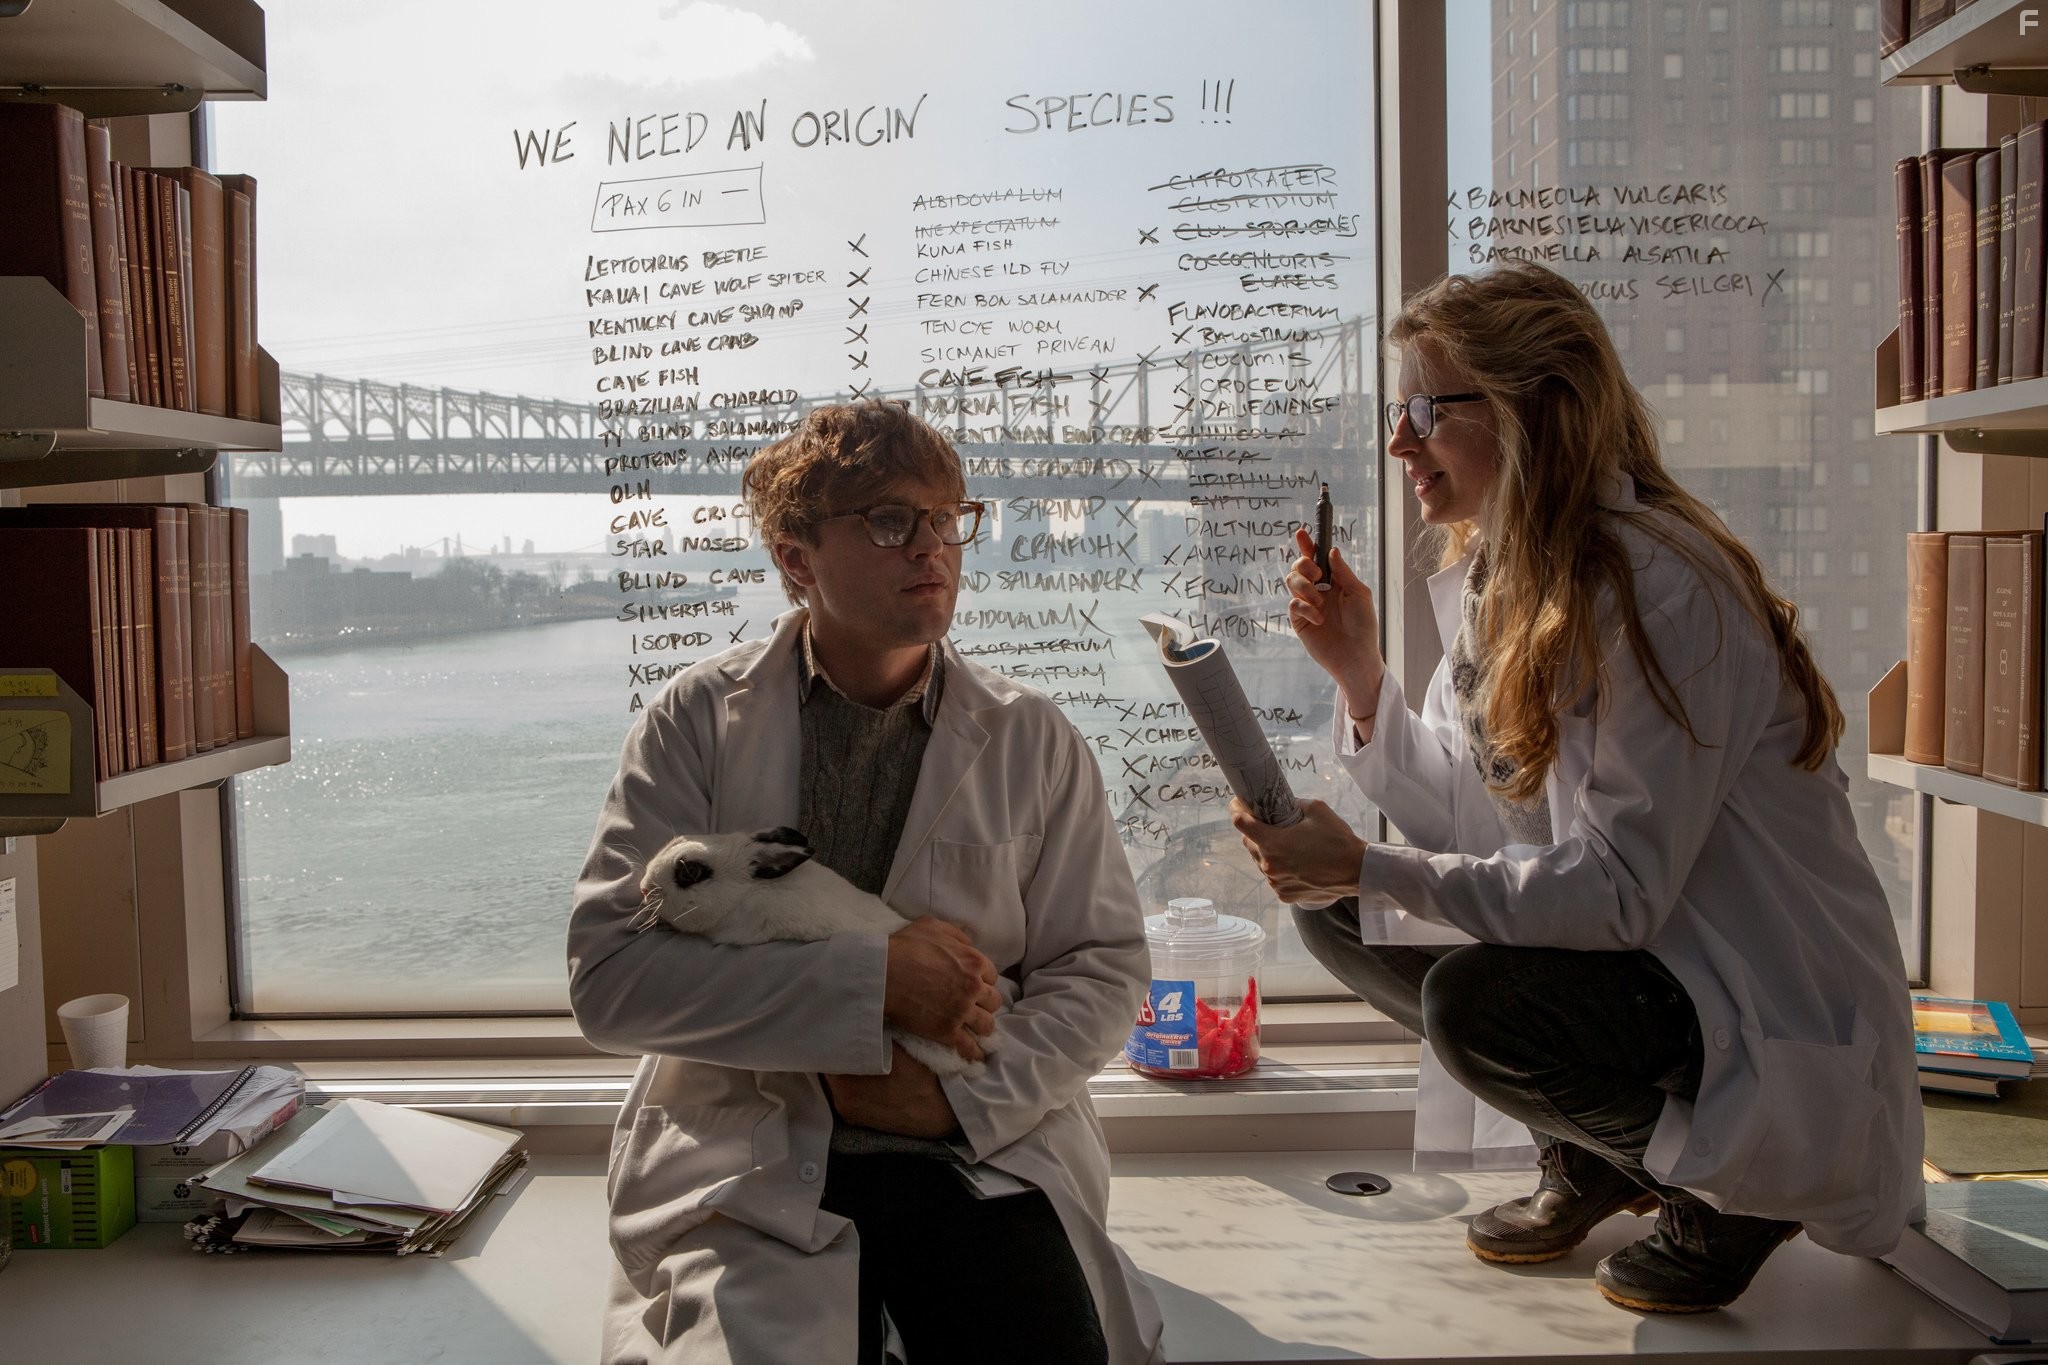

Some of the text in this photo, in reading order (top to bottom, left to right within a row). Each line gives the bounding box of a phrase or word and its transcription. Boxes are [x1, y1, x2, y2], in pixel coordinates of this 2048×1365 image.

[514, 121, 577, 169] WE
[608, 112, 708, 165] NEED
[728, 98, 767, 151] AN
[792, 94, 927, 147] ORIGIN
[1005, 93, 1174, 132] SPECIES
[602, 190, 702, 217] PAX 6 IN
[1467, 183, 1728, 210] BALNEOLA VULGARIS
[702, 246, 768, 269] BEETLE
[916, 239, 1013, 258] KUNA FISH
[915, 264, 995, 284] CHINESE
[1040, 261, 1070, 277] FLY
[659, 280, 706, 299] CAVE
[715, 274, 762, 295] WOLF
[767, 270, 827, 287] SPIDER
[917, 294, 966, 309] FERN
[1017, 289, 1128, 306] SALAMANDER
[589, 311, 677, 338] KENTUCKY
[688, 307, 735, 327] CAVE
[1168, 301, 1344, 325] FLAVOBACTERIUM
[1008, 320, 1063, 335] WORM
[592, 346, 652, 365] BLIND
[660, 337, 702, 357] CAVE
[1201, 352, 1313, 369] CUCUMIS
[597, 367, 699, 392] CAVE FISH
[918, 365, 989, 388] CAVE
[1200, 377, 1319, 394] CROCEUM
[598, 389, 798, 420] BRAZILIAN CHARACID
[1008, 393, 1071, 419] FISH
[638, 422, 692, 442] BLIND
[610, 479, 652, 505] OLM
[610, 503, 752, 534] CAVE CRIC
[1007, 495, 1106, 522] SHRIMP
[612, 537, 749, 558] STAR NOSED
[1183, 545, 1299, 566] AURANTIA
[618, 567, 766, 593] BLIND CAVE
[617, 600, 740, 622] SILVERFISH
[632, 631, 713, 654] ISOPOD
[1158, 991, 1182, 1013] 4
[1160, 1013, 1183, 1022] LBS
